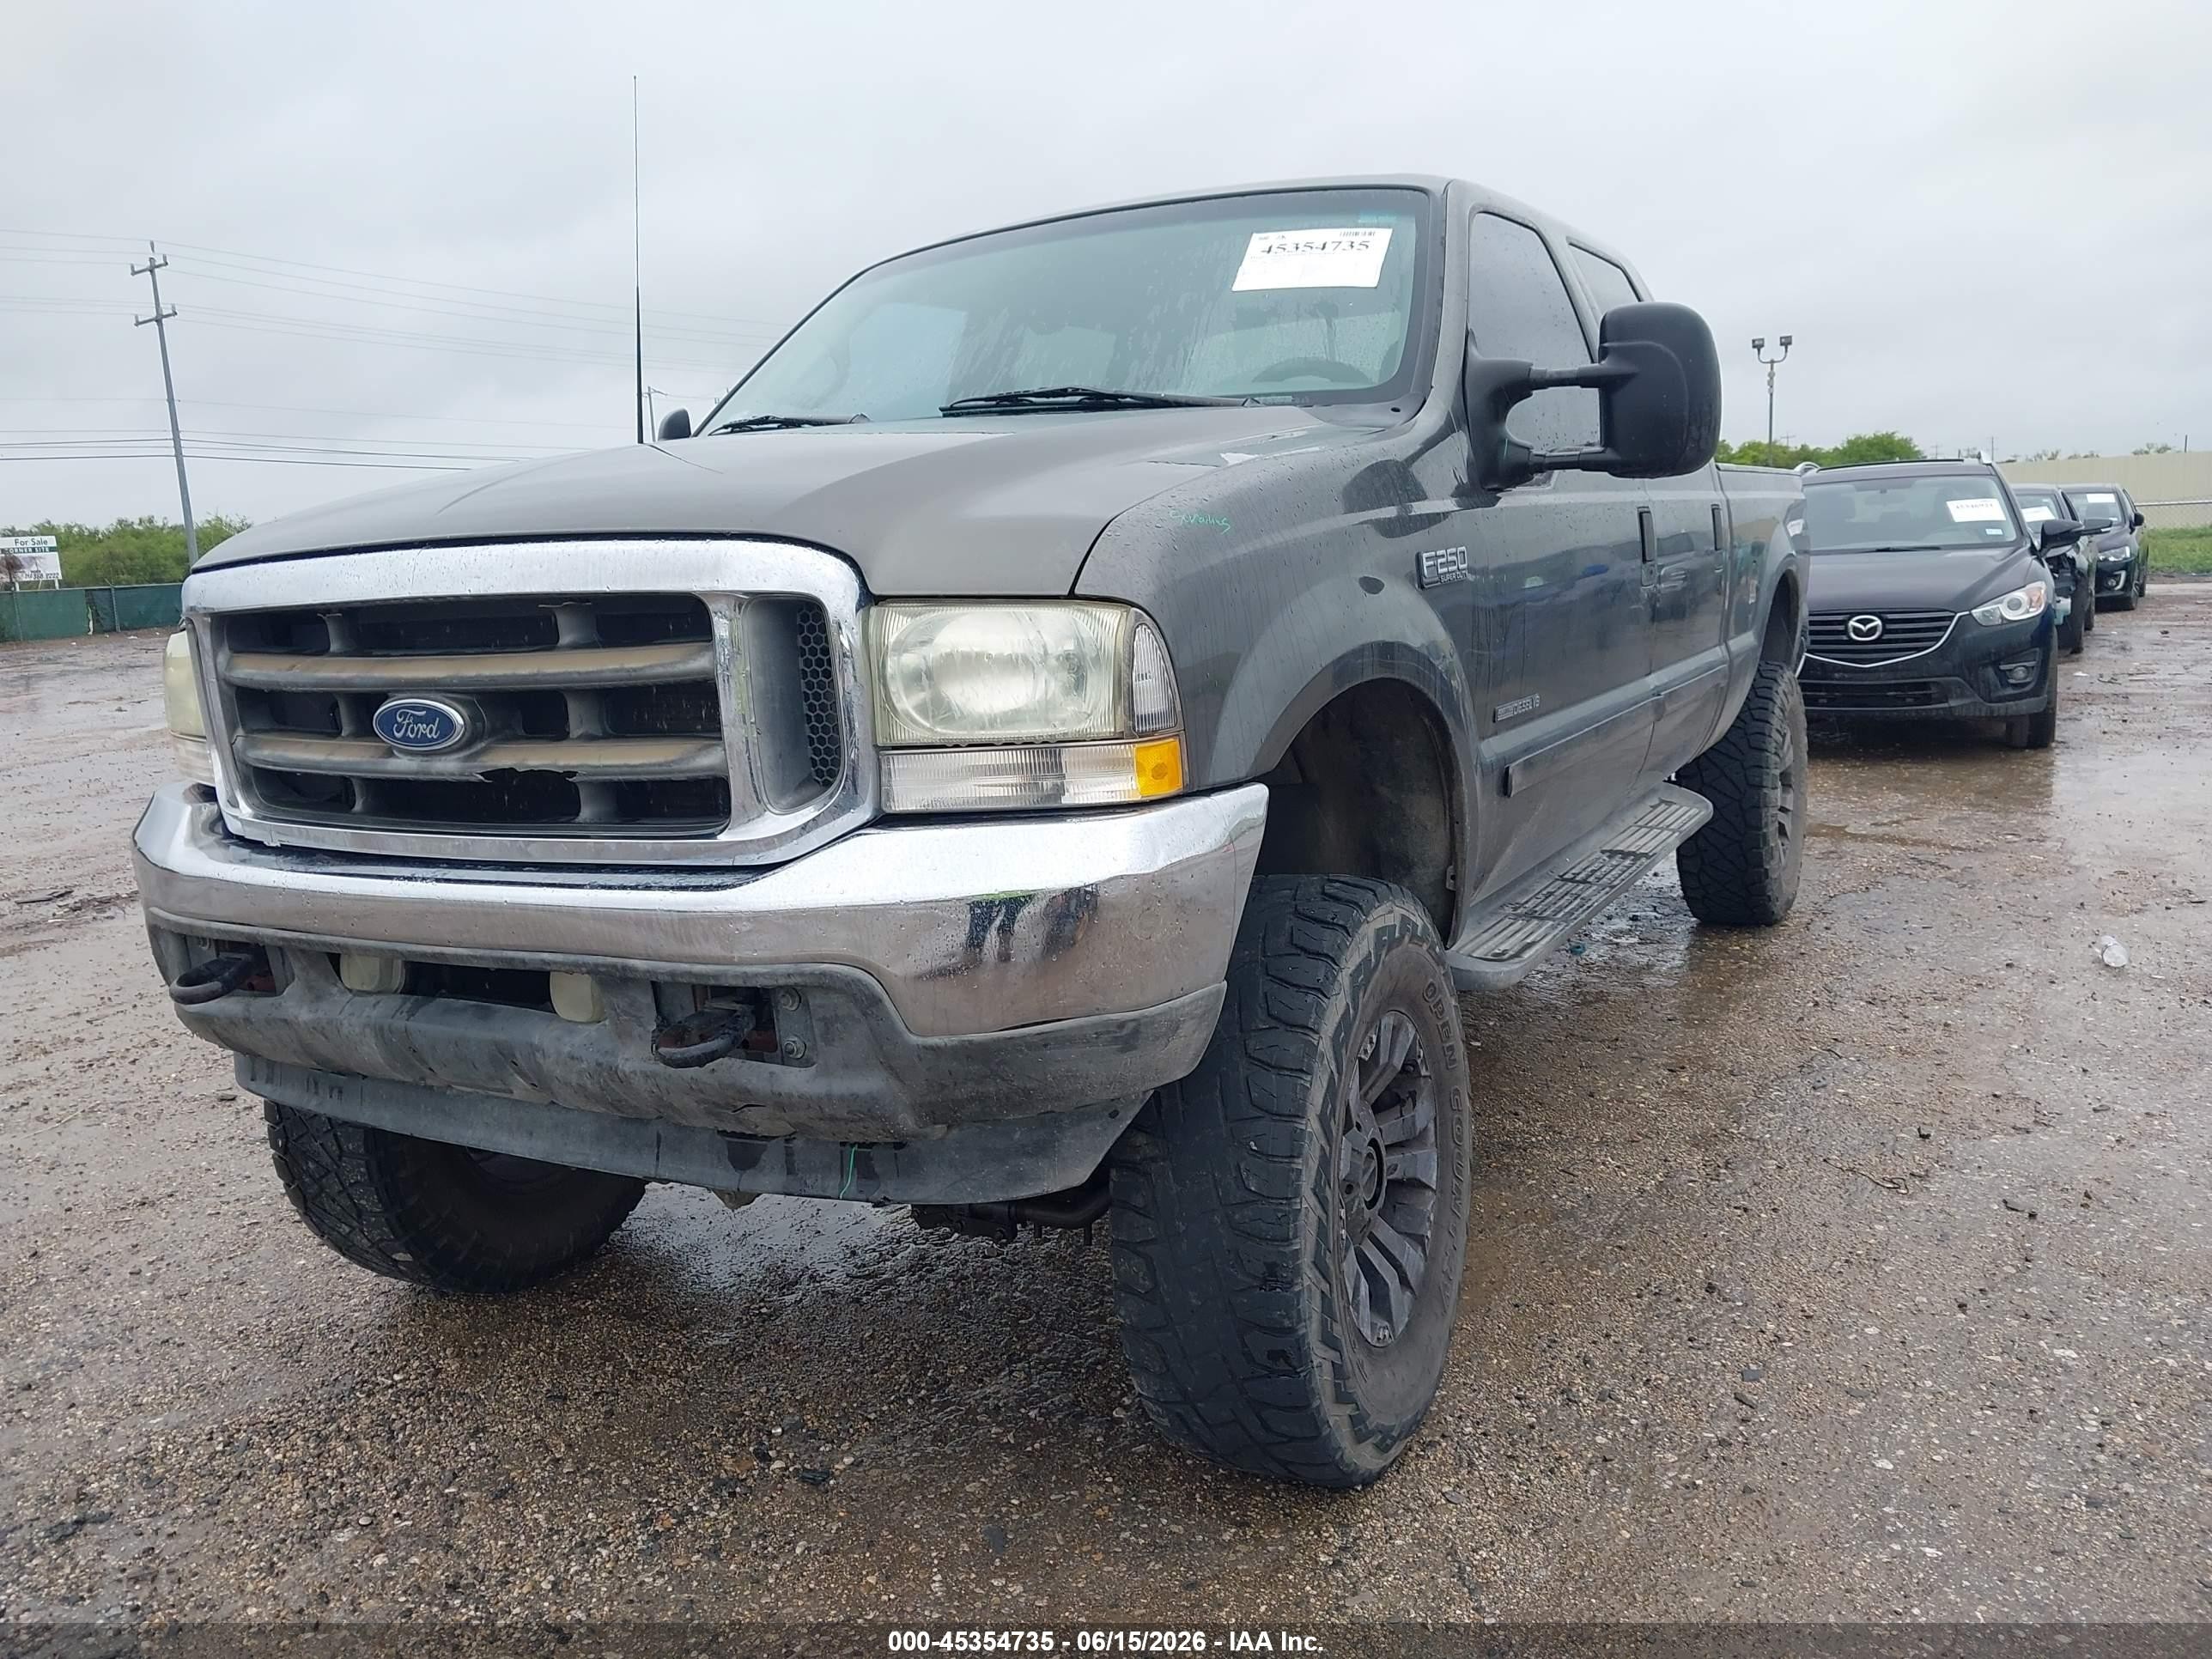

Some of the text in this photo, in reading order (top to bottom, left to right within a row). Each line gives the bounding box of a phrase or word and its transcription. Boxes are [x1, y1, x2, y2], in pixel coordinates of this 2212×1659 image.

[1260, 240, 1371, 255] 45354735
[31, 538, 48, 546] Sale
[392, 708, 441, 738] Ford
[1422, 978, 1458, 1071] OPEN
